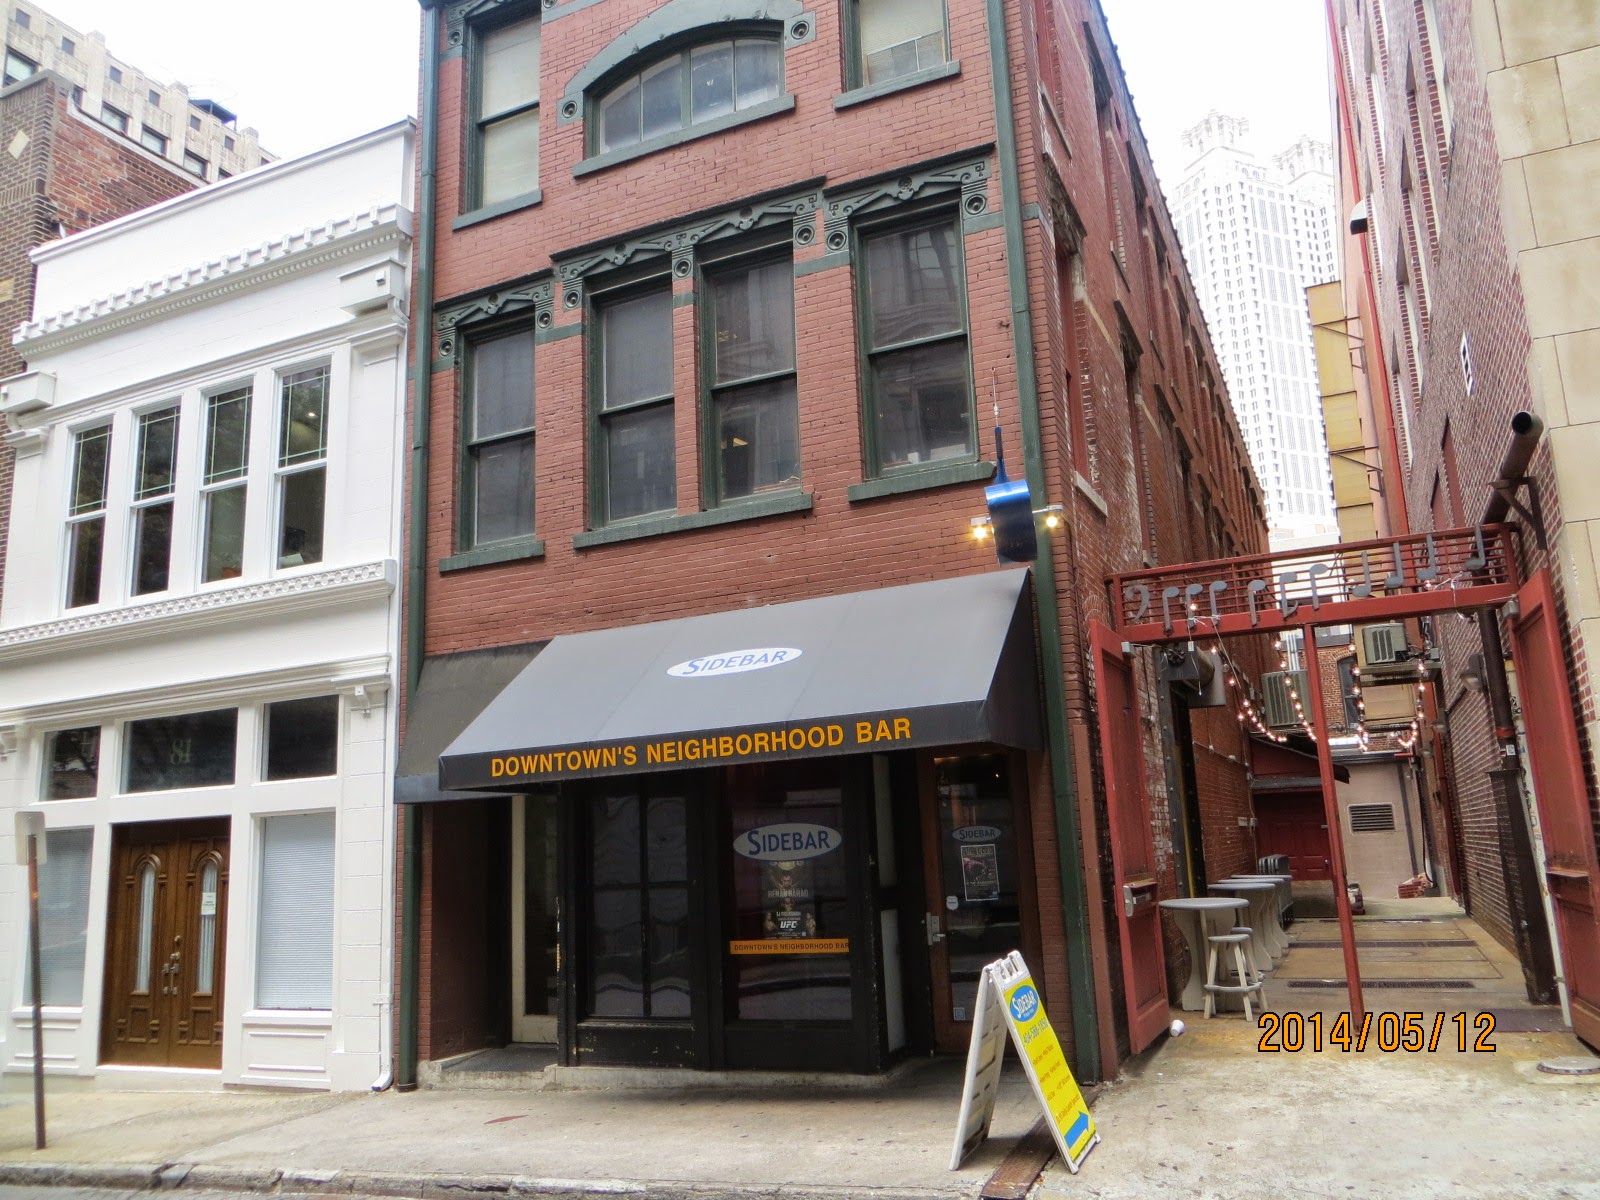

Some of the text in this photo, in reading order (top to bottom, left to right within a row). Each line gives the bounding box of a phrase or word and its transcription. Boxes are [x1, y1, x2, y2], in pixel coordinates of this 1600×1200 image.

[682, 650, 788, 675] SIDEBAR
[491, 717, 912, 777] DOWNTOWN'S NEIGHBORHOOD BAR
[747, 830, 831, 856] SIDEBAR
[959, 828, 996, 840] SIDEBAR
[780, 920, 798, 929] UFC
[780, 942, 834, 950] NEIGHBORHOOD
[1012, 990, 1037, 1018] SIDEBAR
